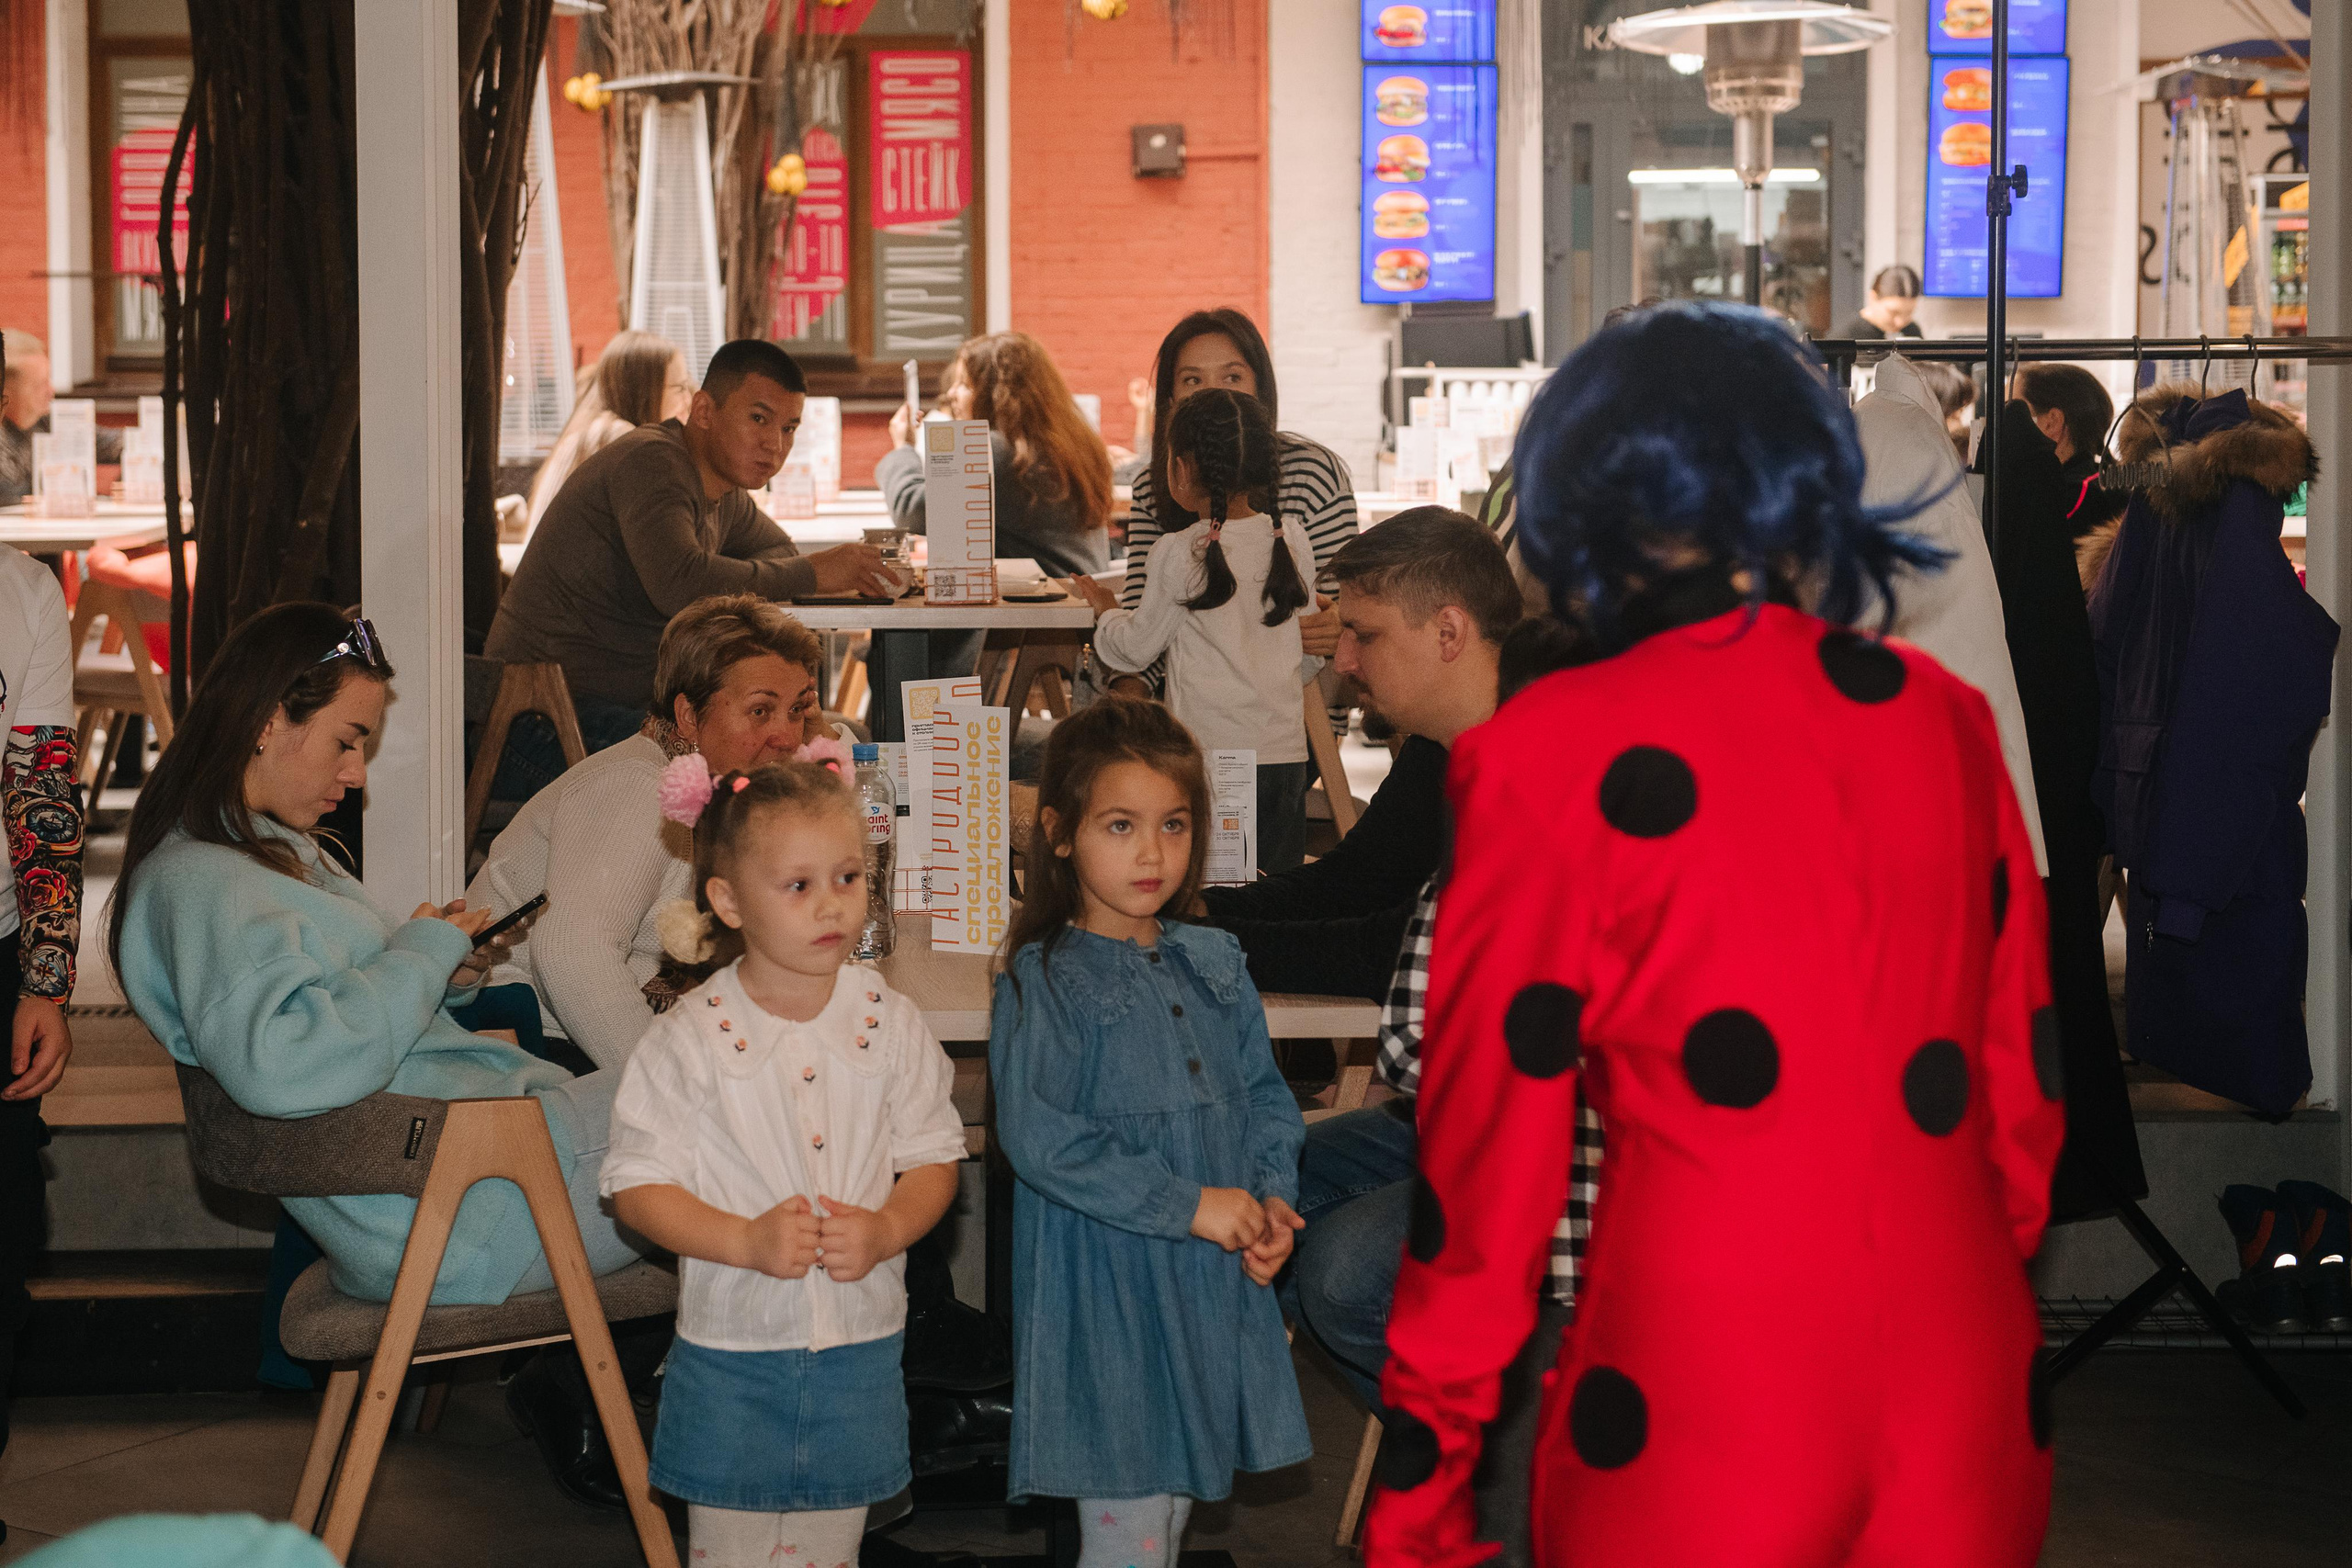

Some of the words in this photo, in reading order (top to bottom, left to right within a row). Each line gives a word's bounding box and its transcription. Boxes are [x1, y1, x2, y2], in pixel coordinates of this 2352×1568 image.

[879, 58, 961, 141] МЯСО
[881, 141, 961, 212] СТЕЙК
[884, 219, 969, 350] КУРИЦА
[867, 813, 888, 824] aint
[967, 721, 983, 945] специальное
[987, 716, 1006, 947] предложение
